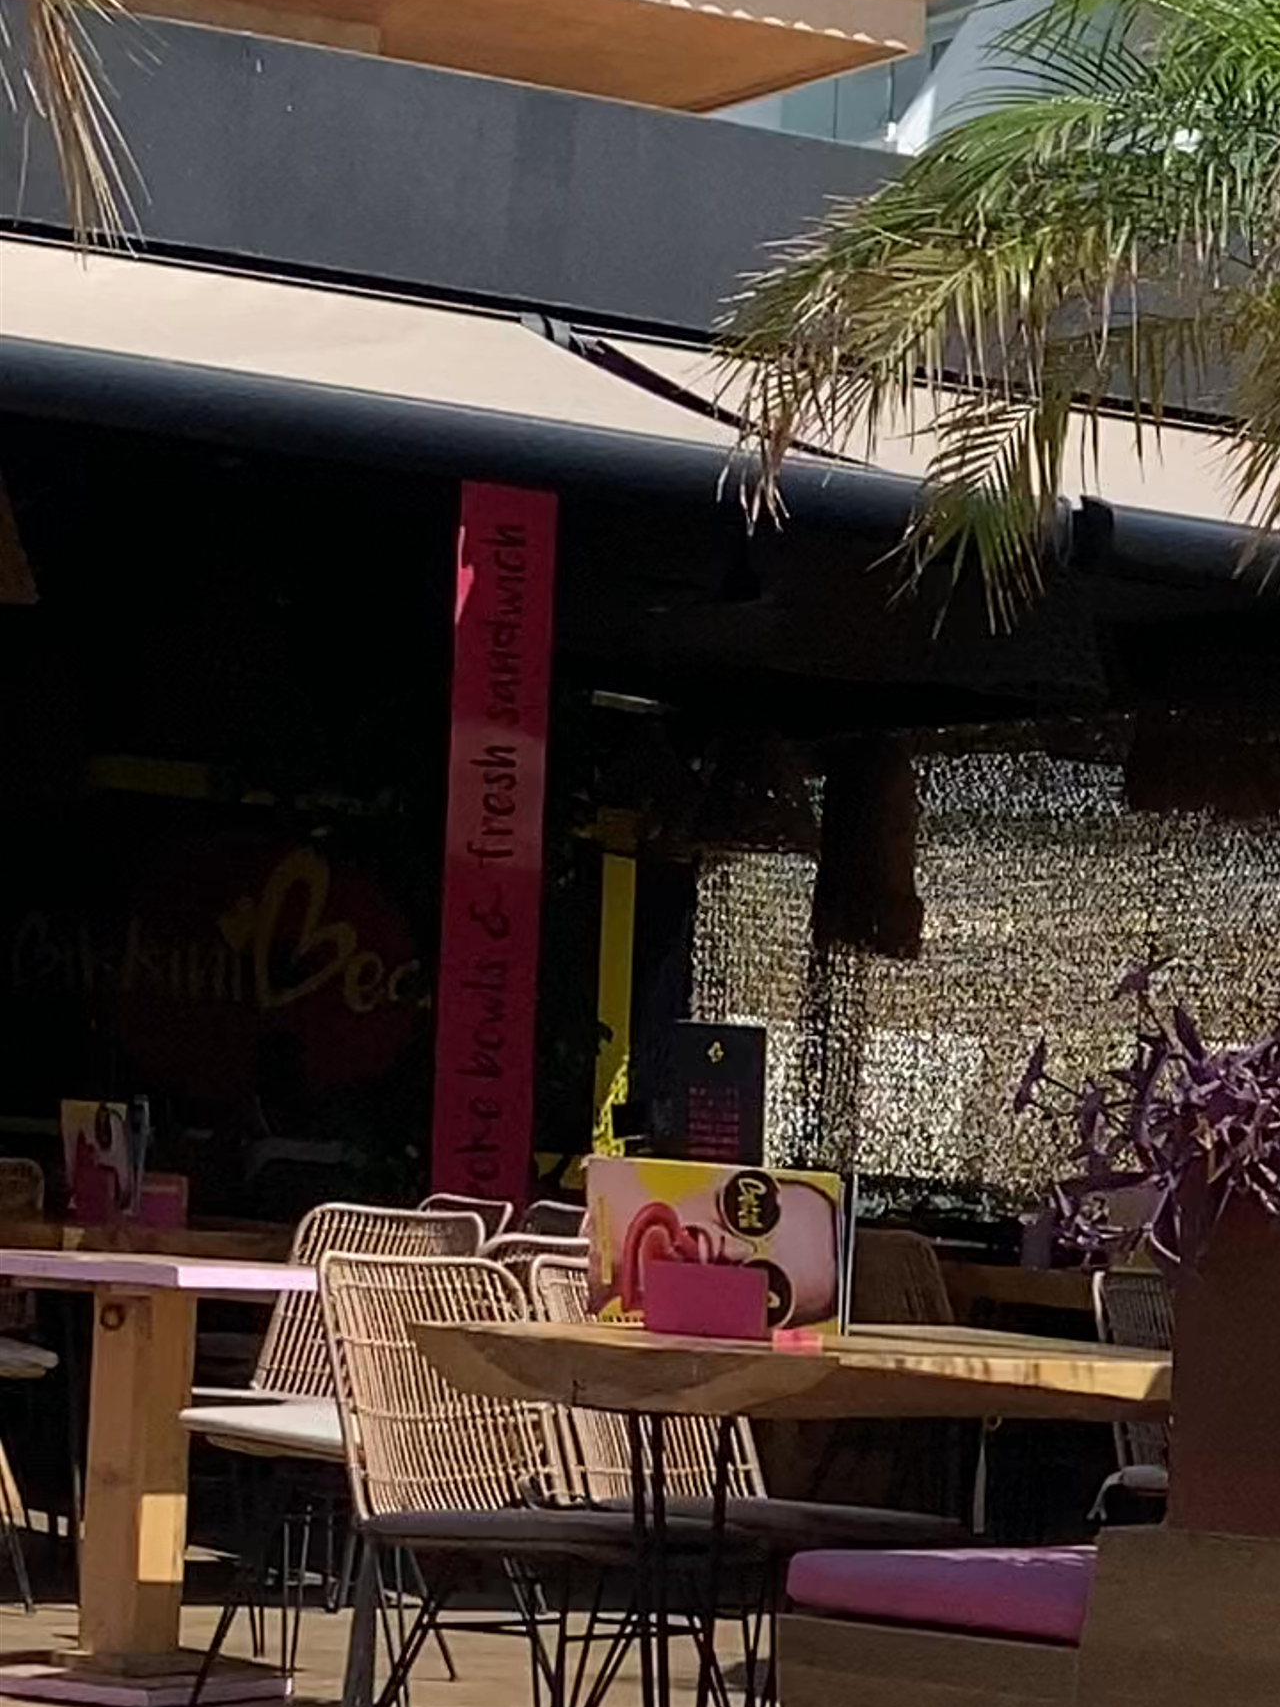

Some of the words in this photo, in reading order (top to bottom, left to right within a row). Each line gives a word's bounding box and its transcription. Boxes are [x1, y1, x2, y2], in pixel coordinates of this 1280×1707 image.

[479, 523, 527, 727] sandwich
[467, 743, 518, 869] fresh
[453, 953, 508, 1079] bowls
